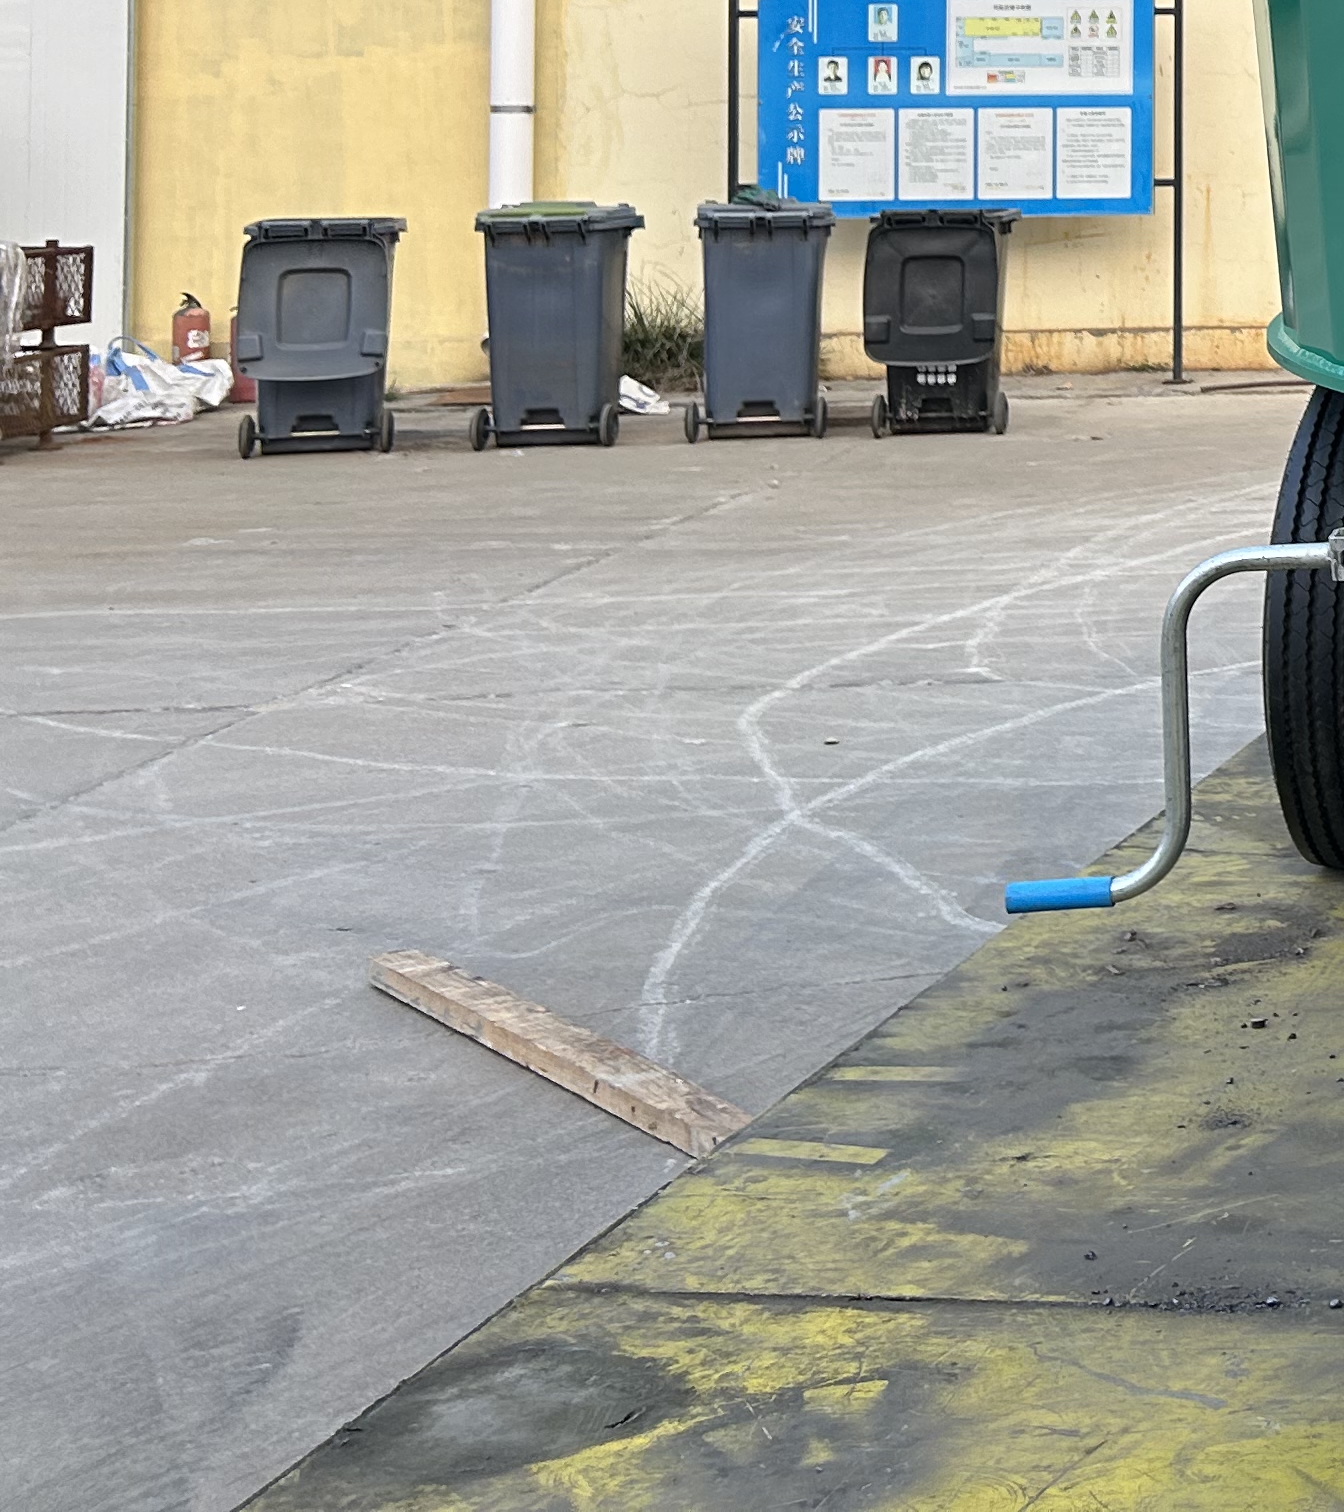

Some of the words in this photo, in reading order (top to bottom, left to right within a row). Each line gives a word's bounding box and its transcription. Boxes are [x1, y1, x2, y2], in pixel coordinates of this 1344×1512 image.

[786, 15, 805, 166] 安全生产公示牌
